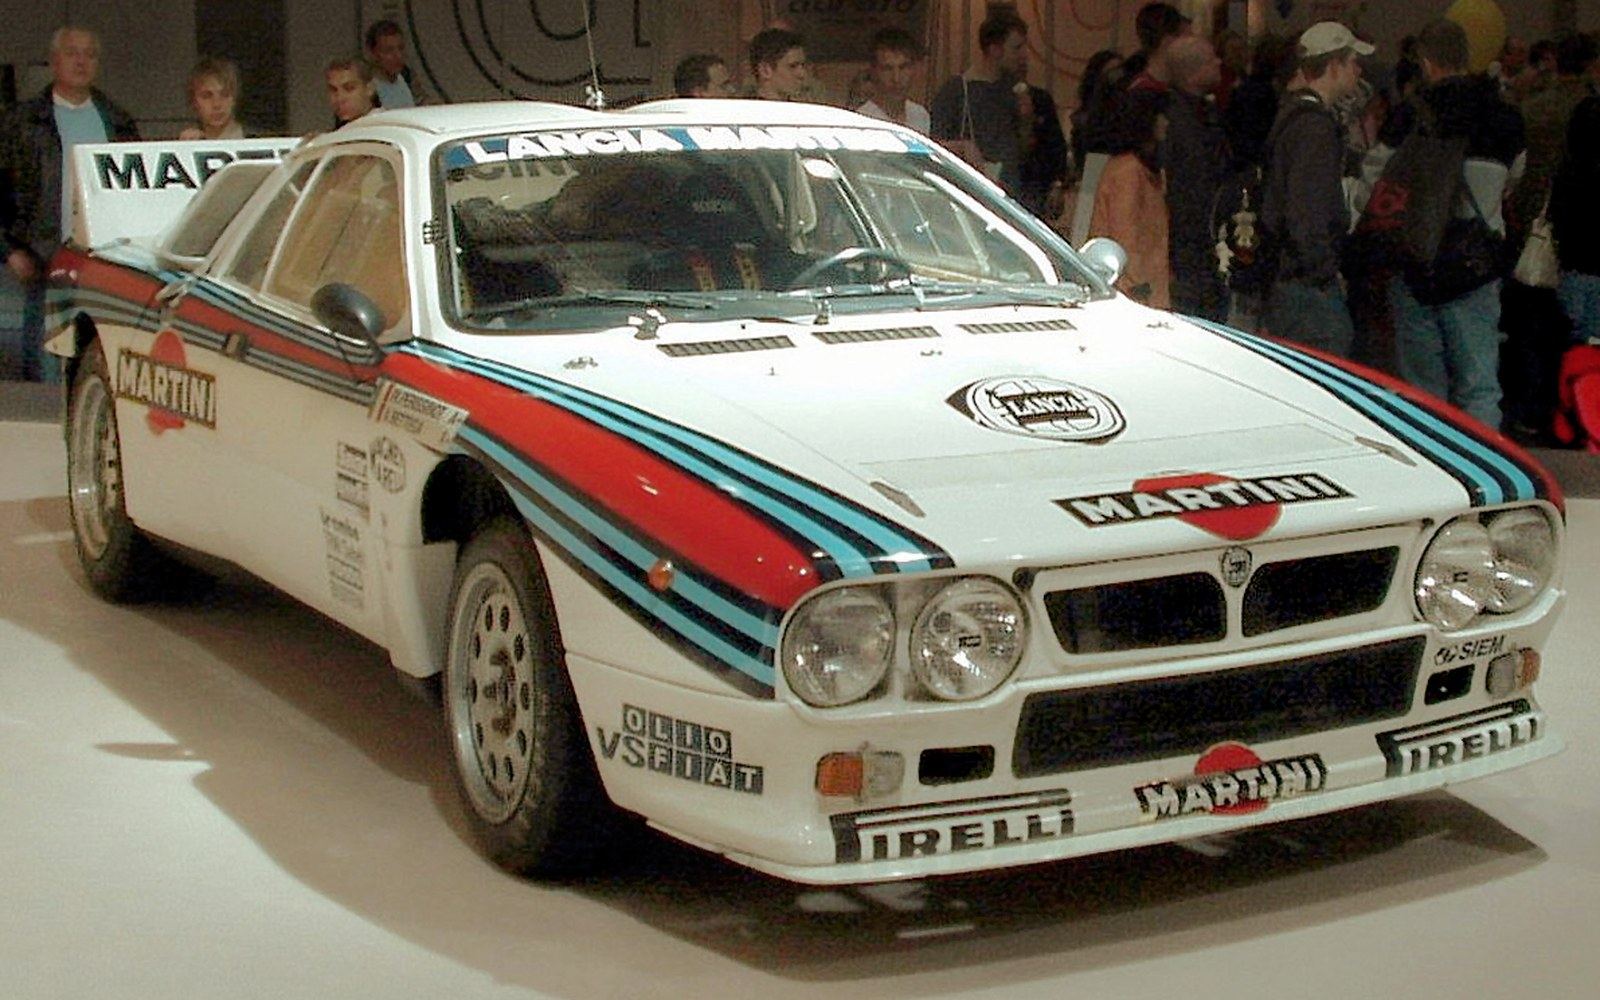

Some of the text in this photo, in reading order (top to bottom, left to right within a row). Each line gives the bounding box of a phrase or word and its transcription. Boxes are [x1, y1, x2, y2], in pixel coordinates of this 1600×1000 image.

[94, 149, 291, 190] MAR
[464, 127, 684, 163] LANCIA
[119, 354, 215, 424] MARTINI
[1005, 395, 1086, 417] LANCIA
[1069, 475, 1341, 524] MARTINI
[624, 706, 730, 756] OLIO
[1375, 698, 1538, 778] PIRELLI
[1137, 757, 1323, 821] MARTINI
[829, 788, 1075, 864] PIRELLI
